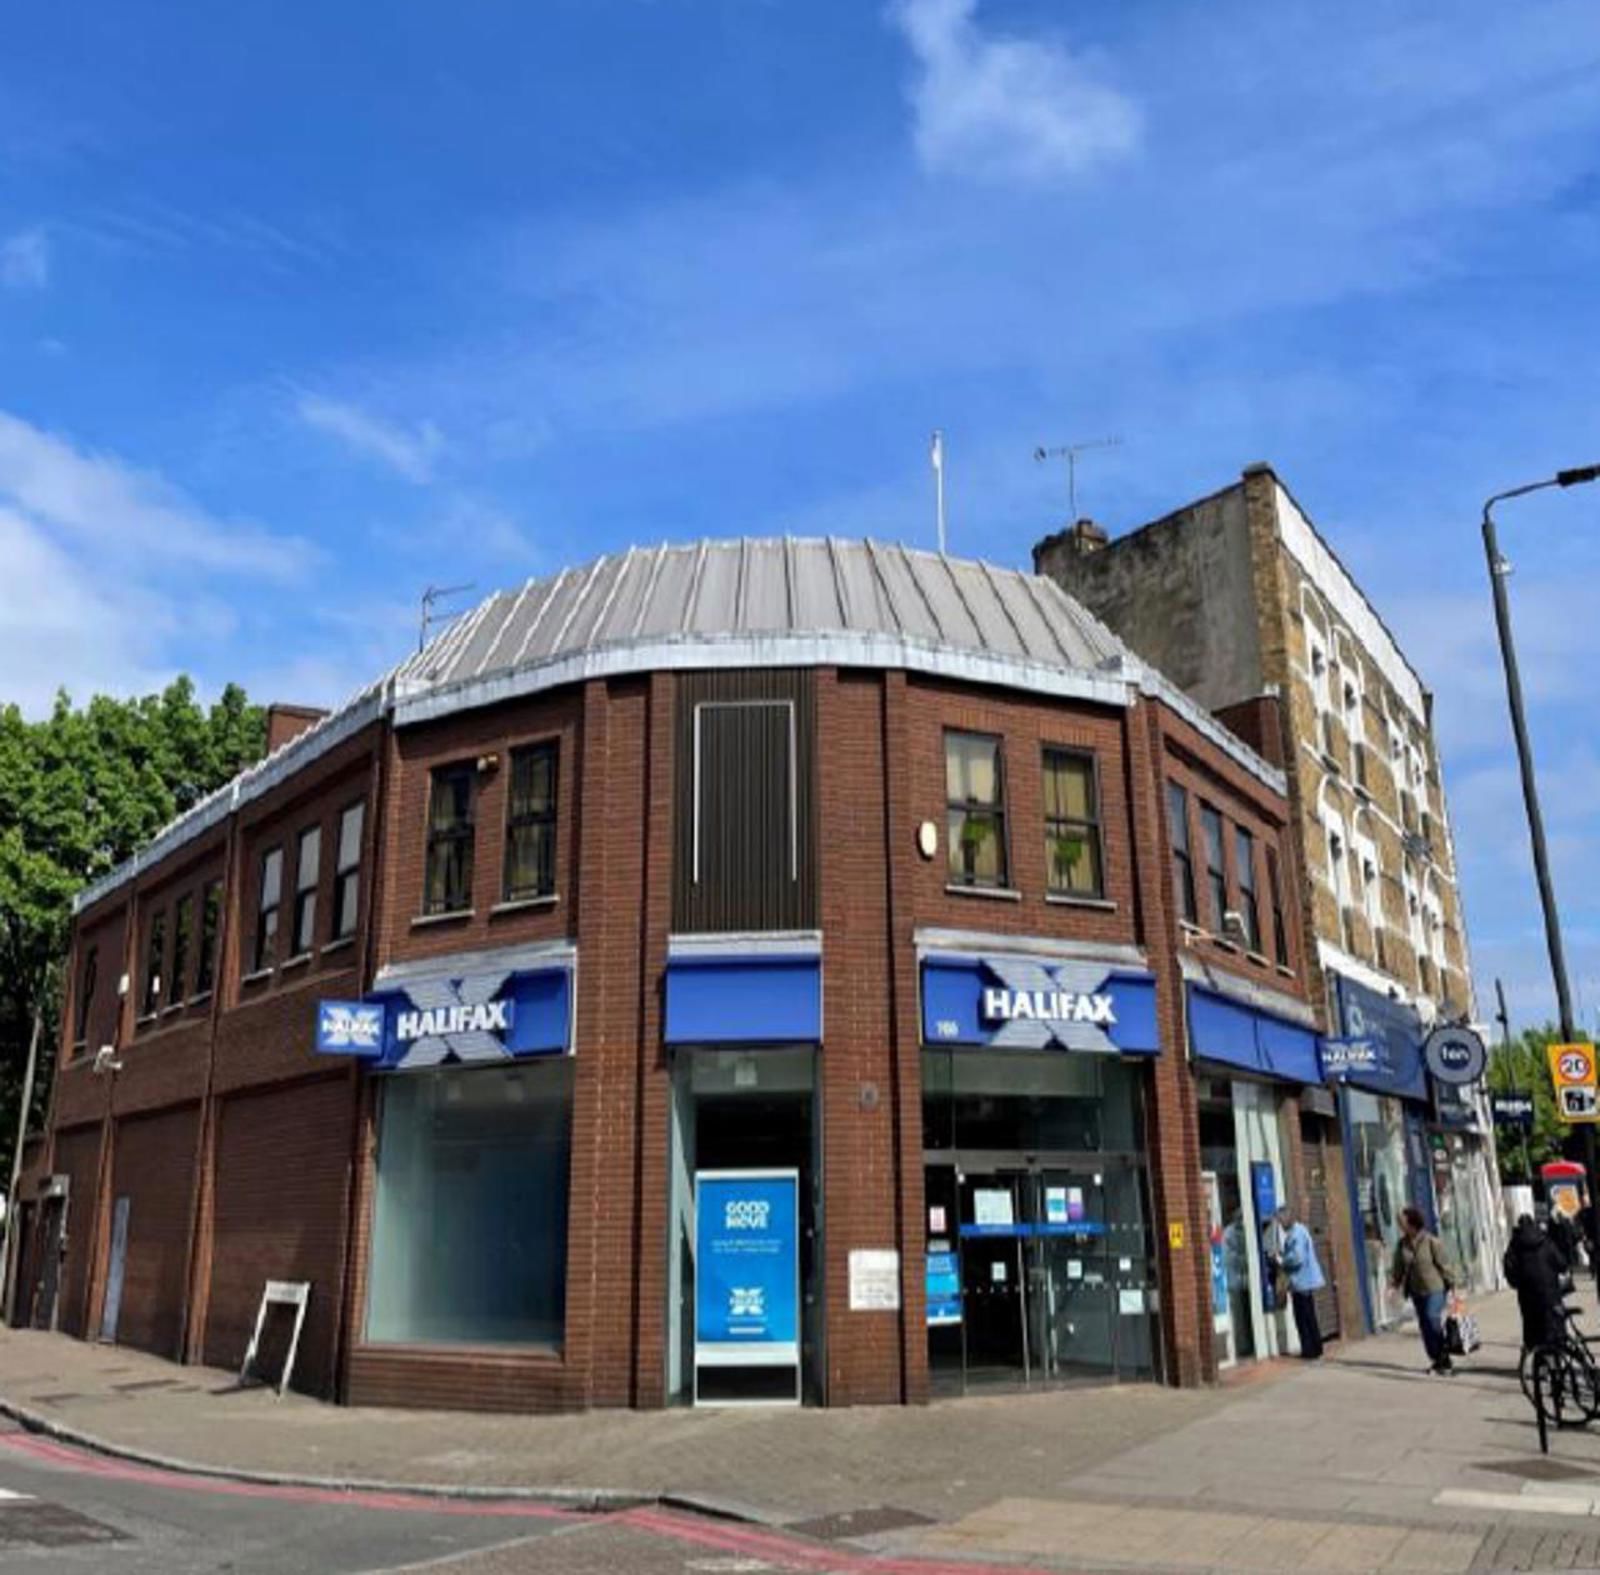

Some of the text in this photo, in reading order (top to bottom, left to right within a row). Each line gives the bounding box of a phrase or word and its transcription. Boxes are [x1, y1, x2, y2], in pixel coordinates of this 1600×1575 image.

[985, 988, 1118, 1023] HALIFAX
[397, 1001, 507, 1040] HALIFAX
[1442, 1046, 1469, 1061] ten
[1563, 1058, 1586, 1074] 20
[726, 1201, 769, 1215] GOOD
